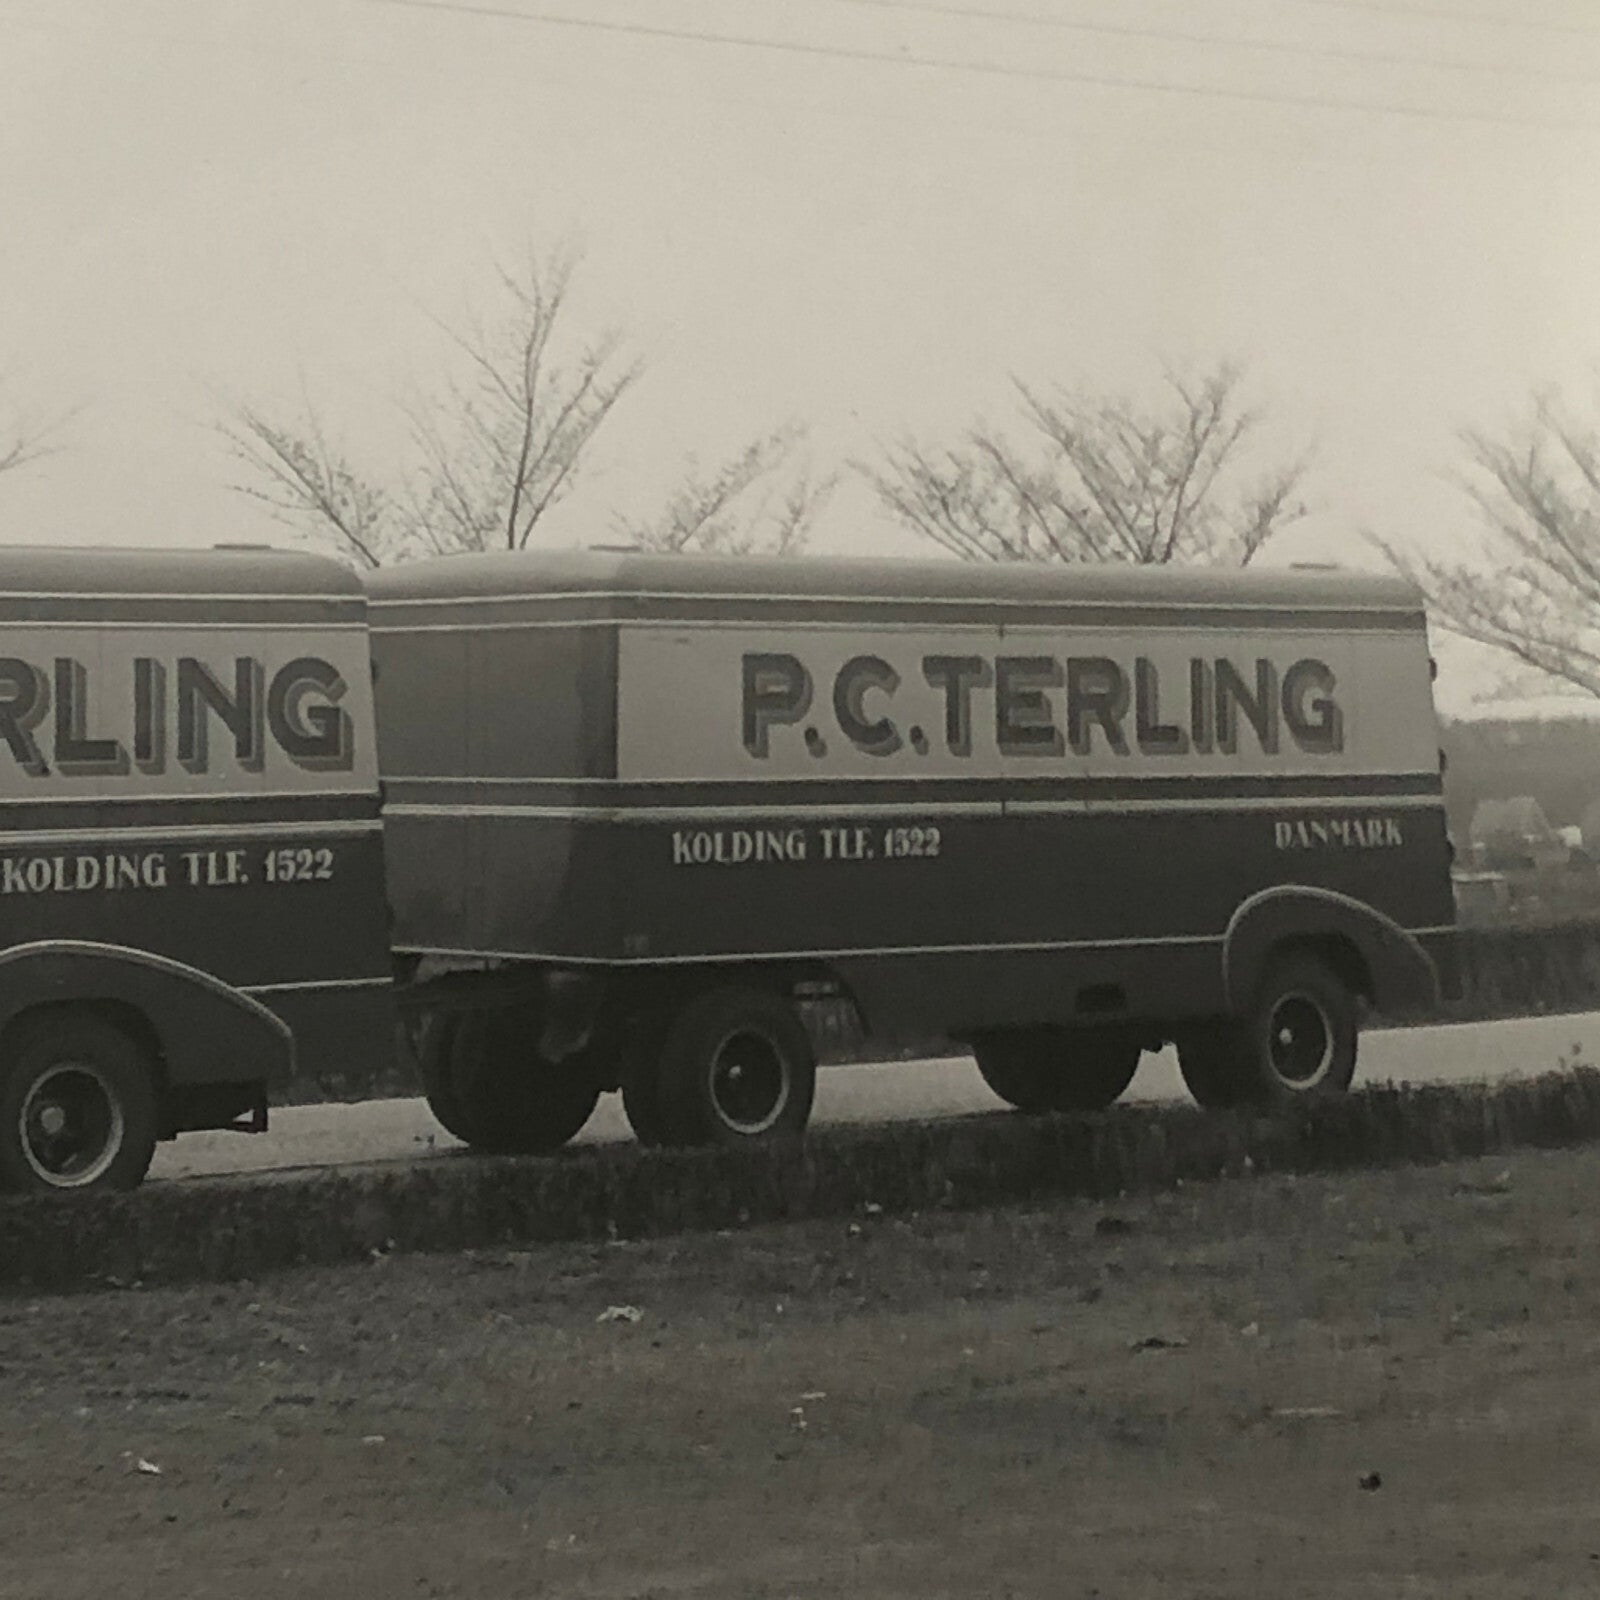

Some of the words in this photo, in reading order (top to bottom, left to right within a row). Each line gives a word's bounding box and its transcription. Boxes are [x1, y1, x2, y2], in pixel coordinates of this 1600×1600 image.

[0, 657, 354, 777] RLING
[672, 829, 806, 864] KOLDING
[884, 827, 941, 858] 1522
[1275, 819, 1403, 849] DANMARK
[2, 853, 167, 894] KOLDING
[181, 850, 249, 886] TLF.
[264, 848, 333, 881] 1522
